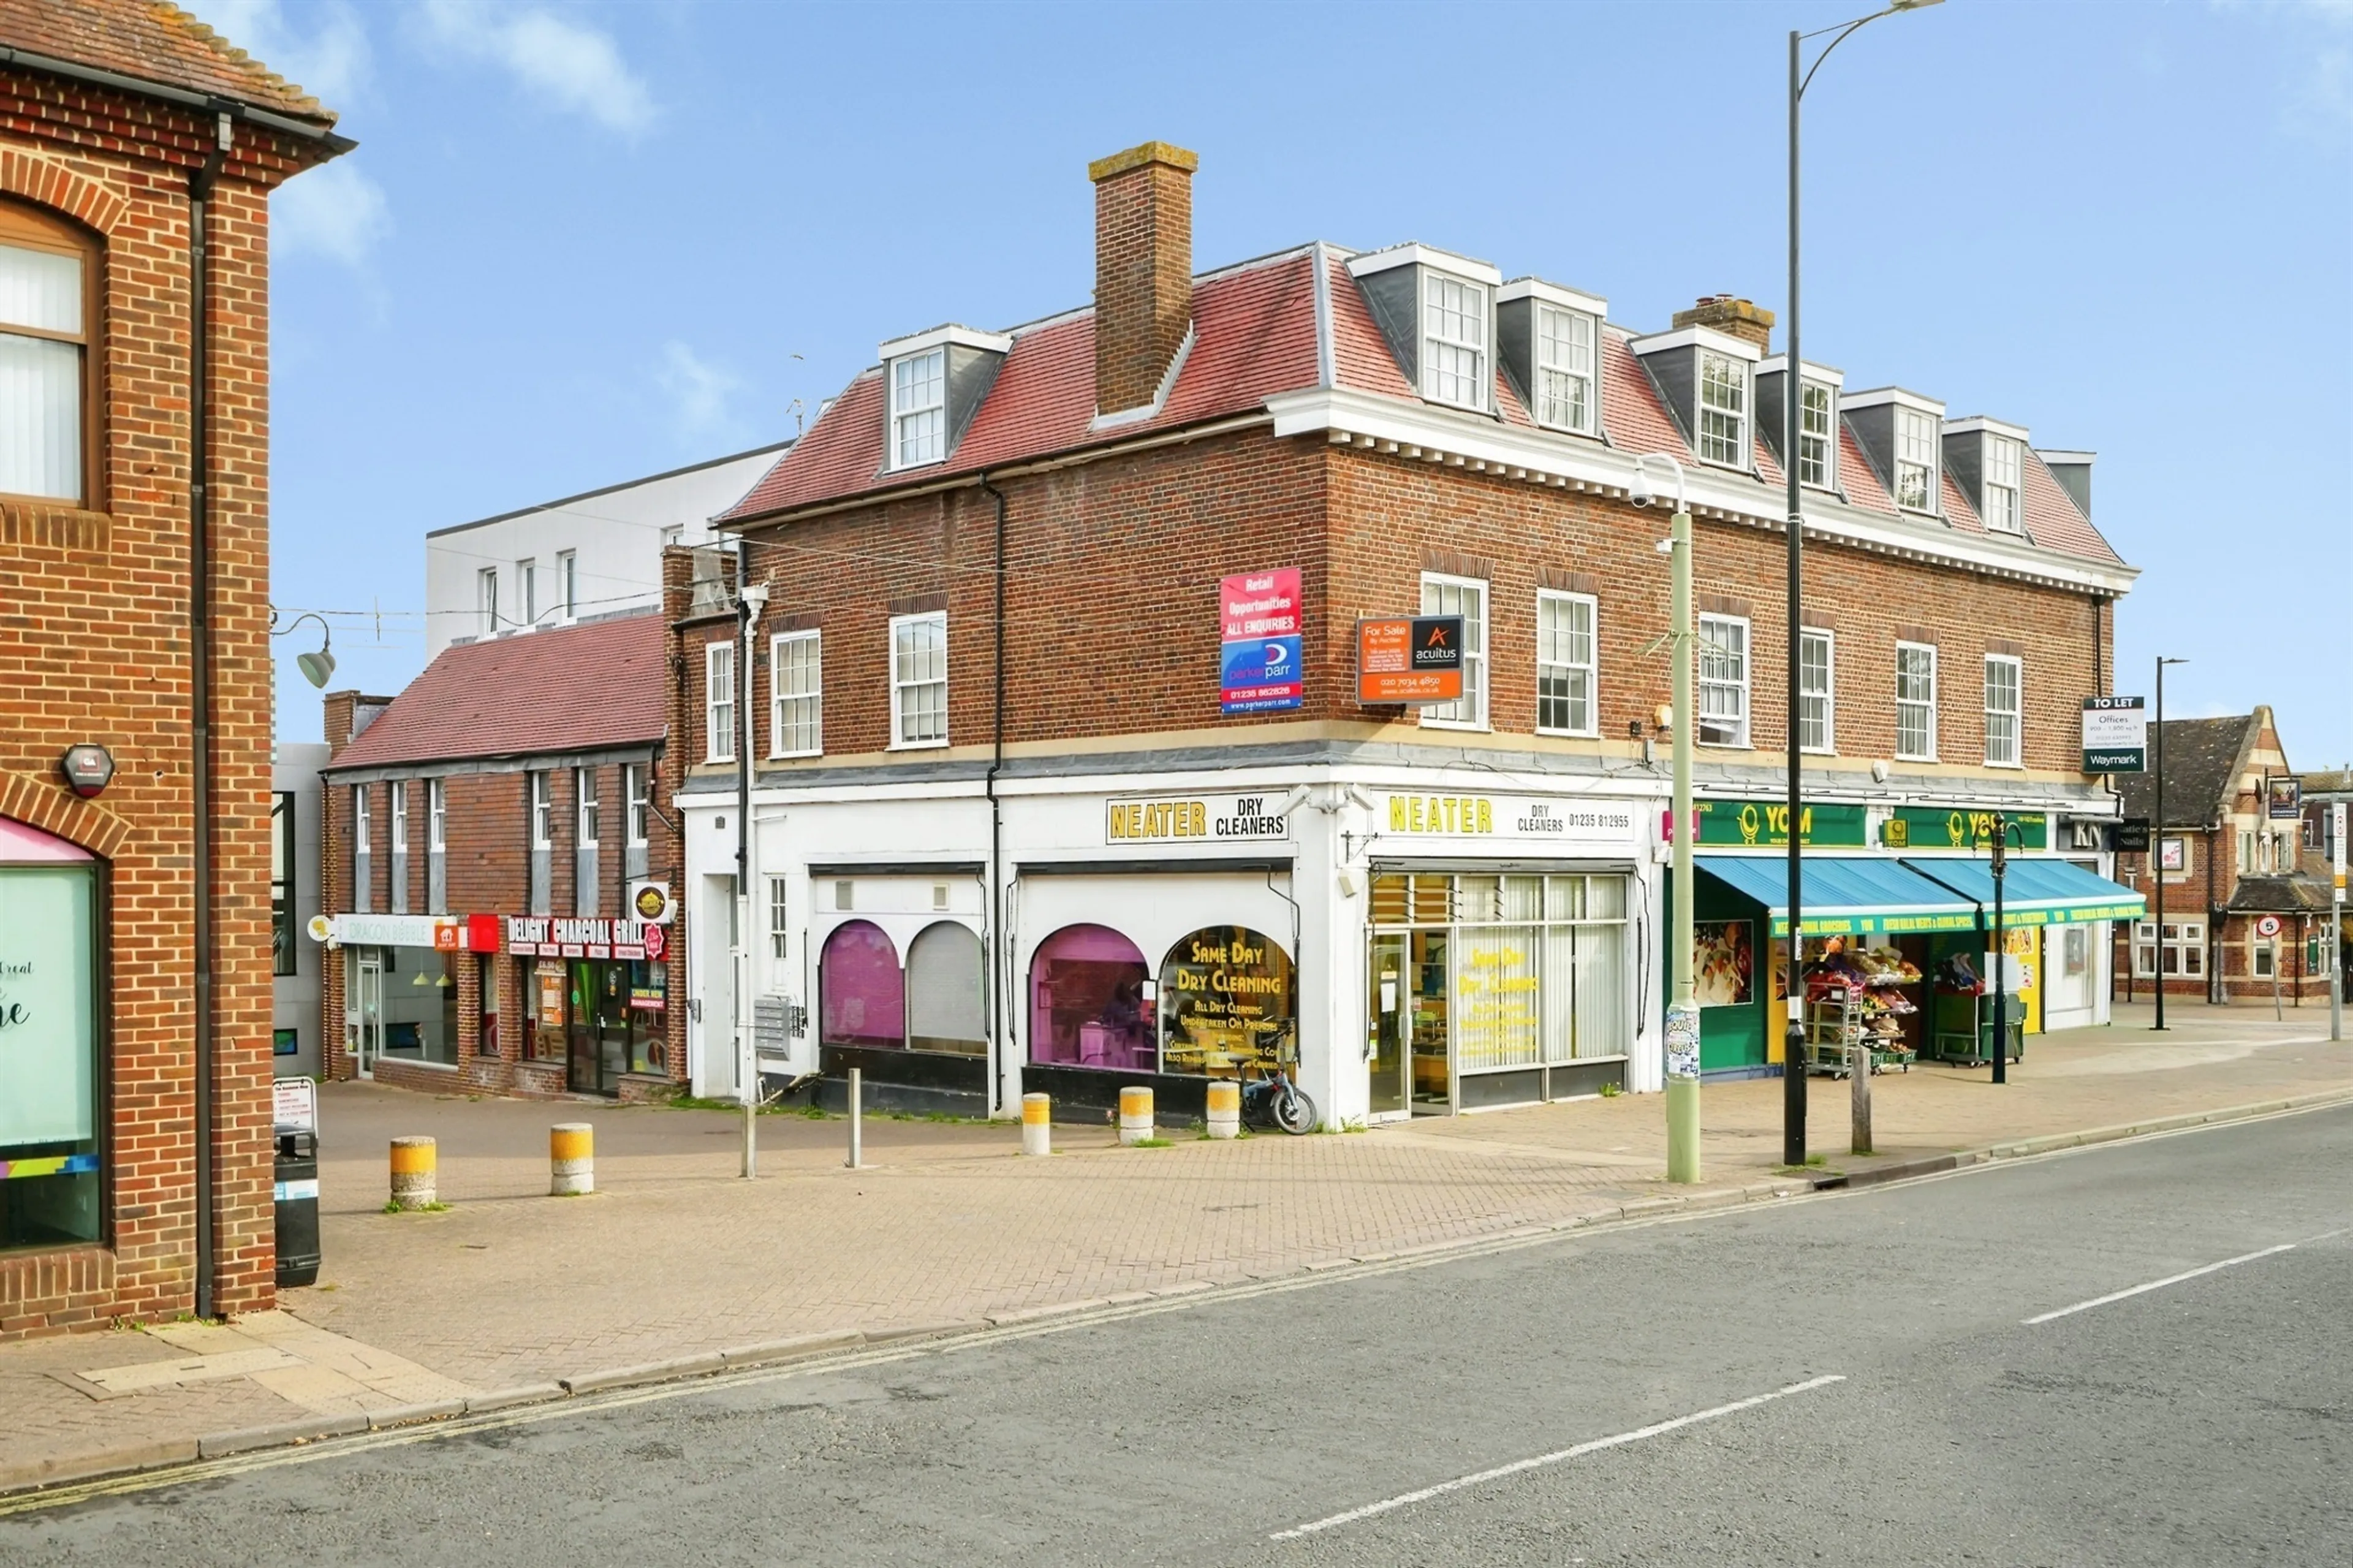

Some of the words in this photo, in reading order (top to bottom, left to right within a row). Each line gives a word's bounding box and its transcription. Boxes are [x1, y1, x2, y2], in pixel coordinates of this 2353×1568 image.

[1246, 576, 1273, 591] Retail
[1229, 596, 1291, 617] Opportunities
[1227, 622, 1243, 637] ALL
[1245, 615, 1295, 634] ENQUIRIES
[1365, 626, 1381, 637] For
[1384, 625, 1406, 636] Sale
[1416, 647, 1456, 659] acuitus
[1398, 678, 1417, 687] 7034
[1419, 676, 1441, 686] 4850
[1230, 689, 1256, 699] 01235
[1230, 699, 1291, 709] www.parkerparr.com
[2094, 698, 2111, 708] TO
[2114, 698, 2134, 708] LET
[2099, 714, 2128, 724] Offices
[2090, 754, 2137, 767] Waymark
[1238, 798, 1264, 816] DRY
[1531, 805, 1549, 817] DRY
[1110, 801, 1207, 839] NEATER
[1389, 797, 1493, 833] NEATER
[1569, 813, 1596, 827] 01235
[1598, 814, 1629, 828] 812955
[1766, 806, 1811, 834] YOM
[1216, 816, 1284, 836] CLEANERS
[1518, 818, 1563, 832] CLEANERS
[2075, 822, 2102, 849] KN
[349, 922, 390, 940] DRAGON
[508, 918, 549, 942] DELIGHT
[553, 918, 611, 944] CHARCOAL
[613, 919, 645, 944] GRILL
[2265, 921, 2273, 931] 5
[1192, 941, 1227, 963] SAME
[1232, 942, 1264, 964] DAY
[1177, 968, 1208, 991] DRY
[1211, 969, 1281, 994] CLEANING
